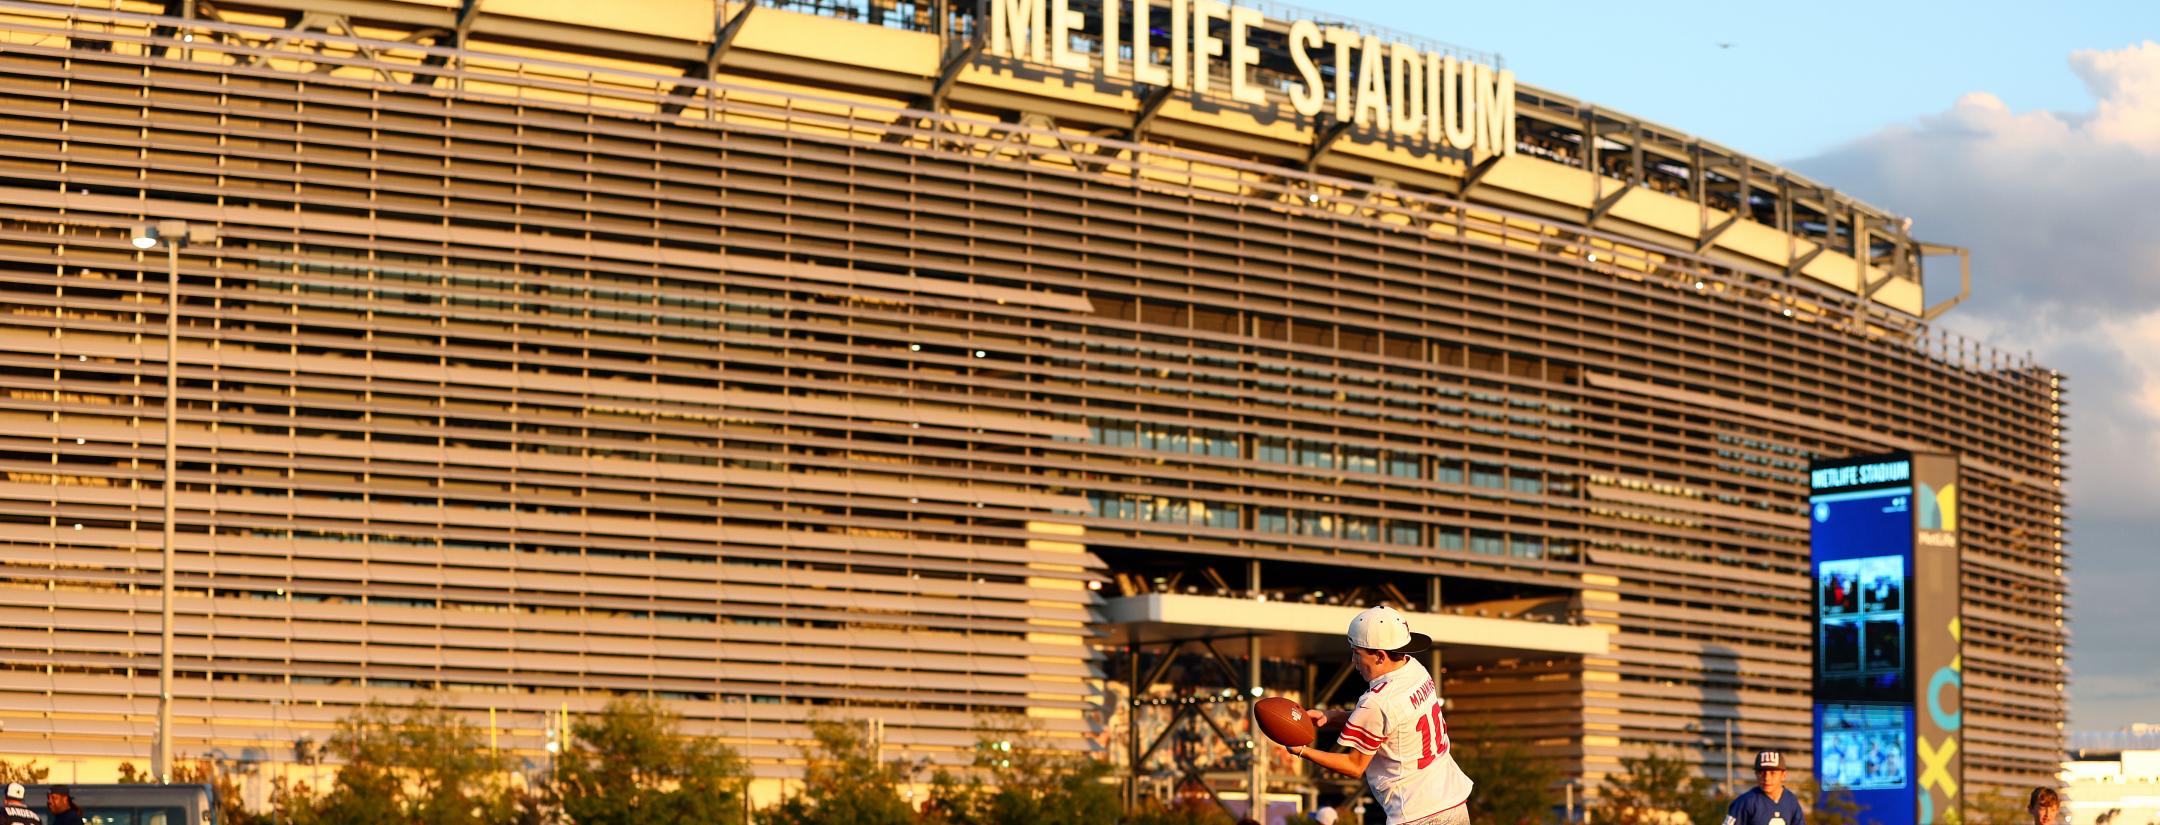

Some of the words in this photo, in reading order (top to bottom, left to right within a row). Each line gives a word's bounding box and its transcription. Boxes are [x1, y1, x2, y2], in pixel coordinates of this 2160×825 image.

[991, 0, 1269, 105] METLIFE
[1289, 19, 1516, 158] STADIUM
[1811, 465, 1858, 489] METLIFE
[1859, 460, 1910, 484] STADIUM
[1416, 701, 1449, 769] 10
